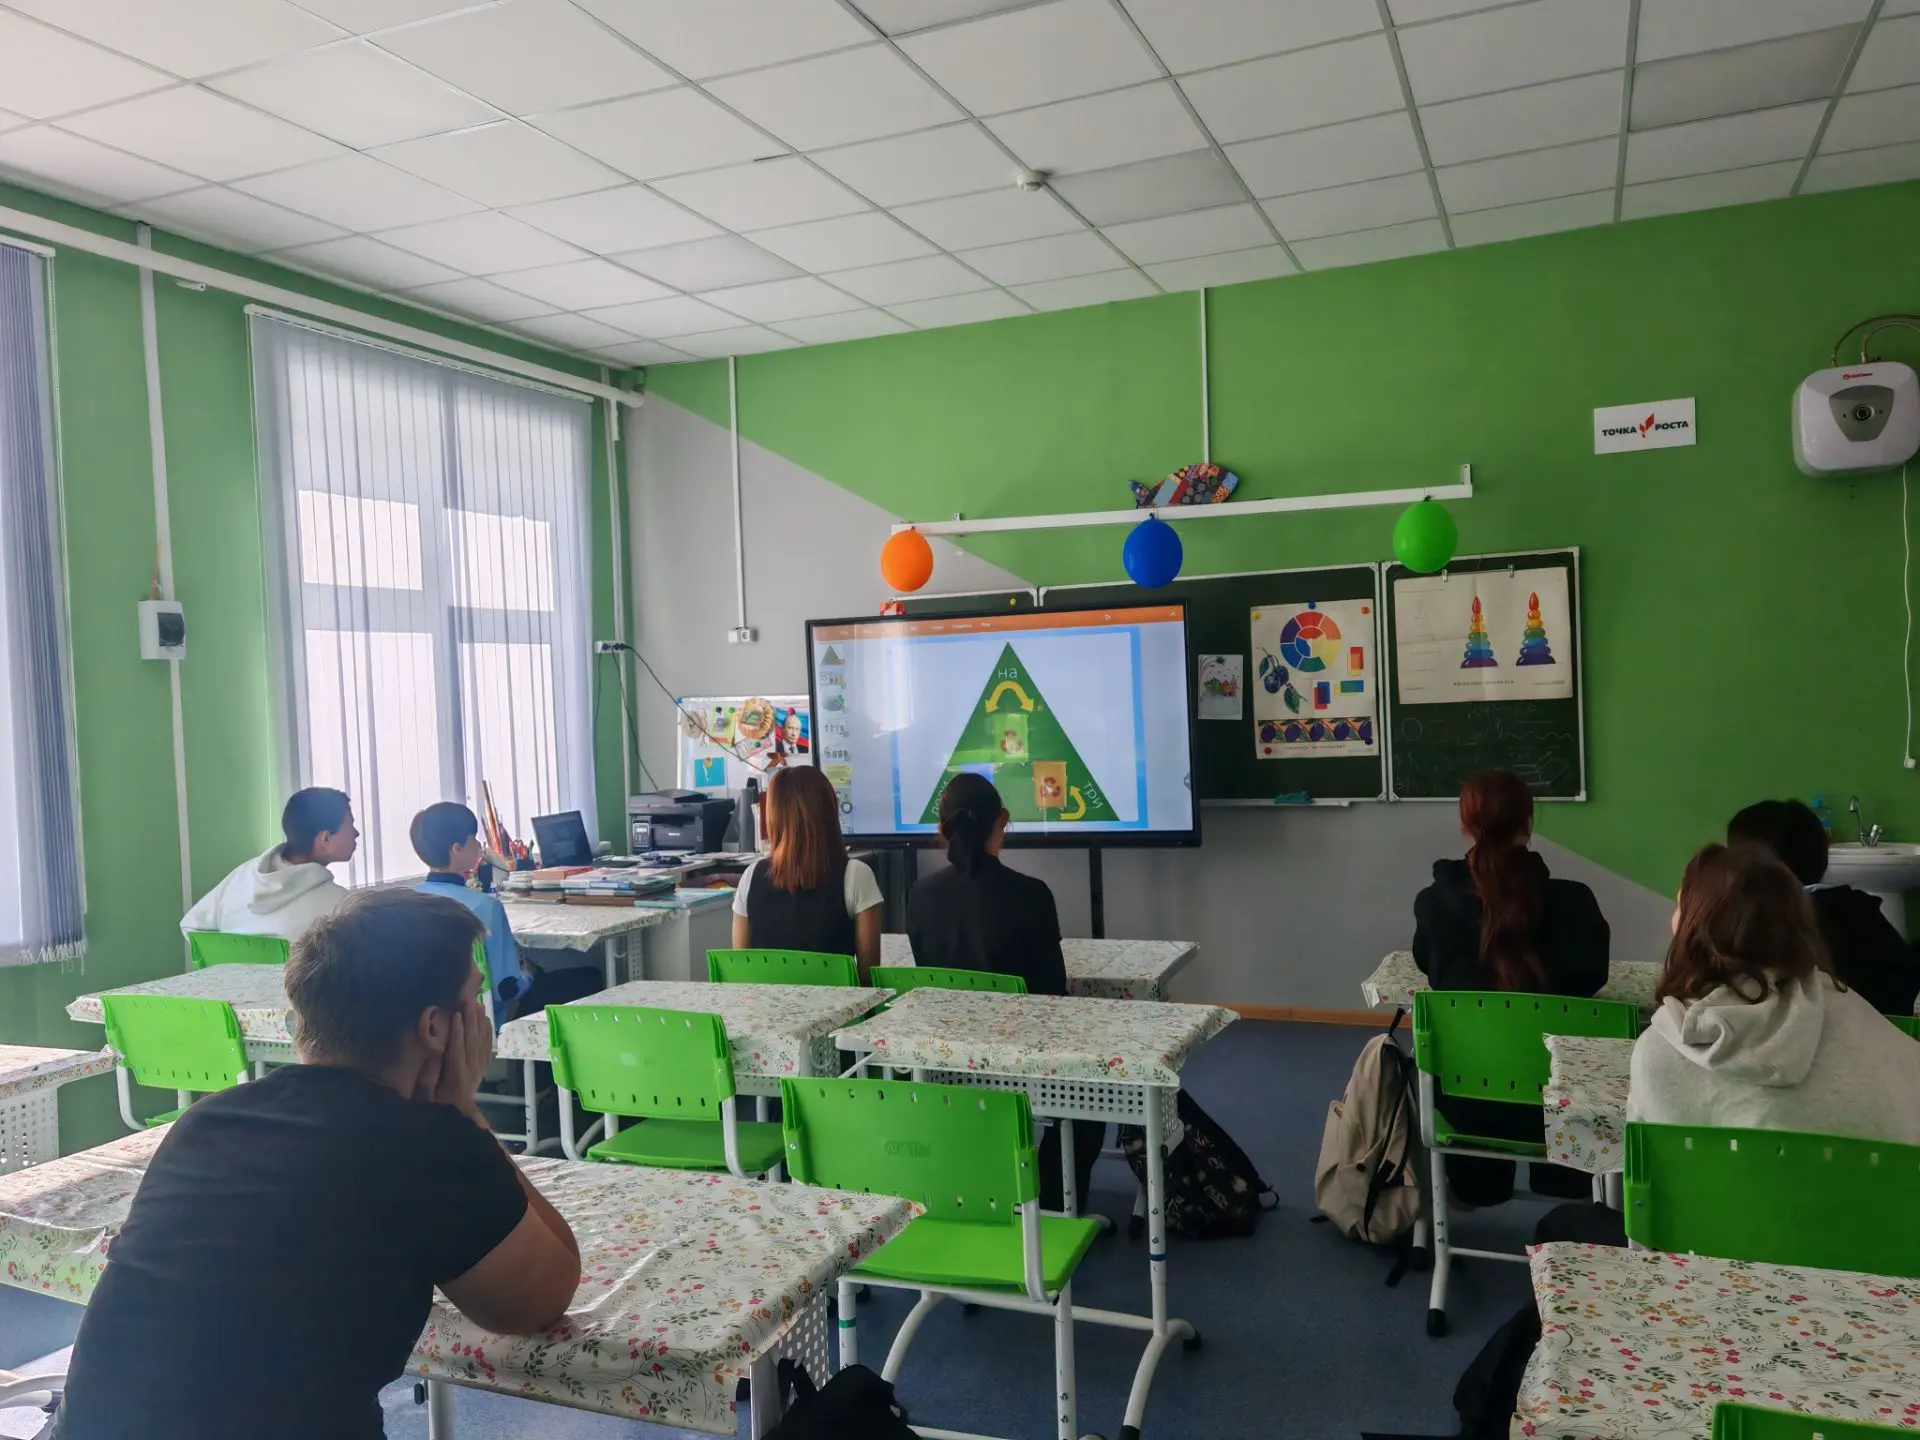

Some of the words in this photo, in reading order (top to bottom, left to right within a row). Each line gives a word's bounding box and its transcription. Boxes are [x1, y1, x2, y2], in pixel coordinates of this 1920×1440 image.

[1602, 426, 1637, 437] ТОЧКА
[1655, 420, 1689, 431] РОСТА
[998, 668, 1017, 679] на
[1083, 780, 1104, 809] три
